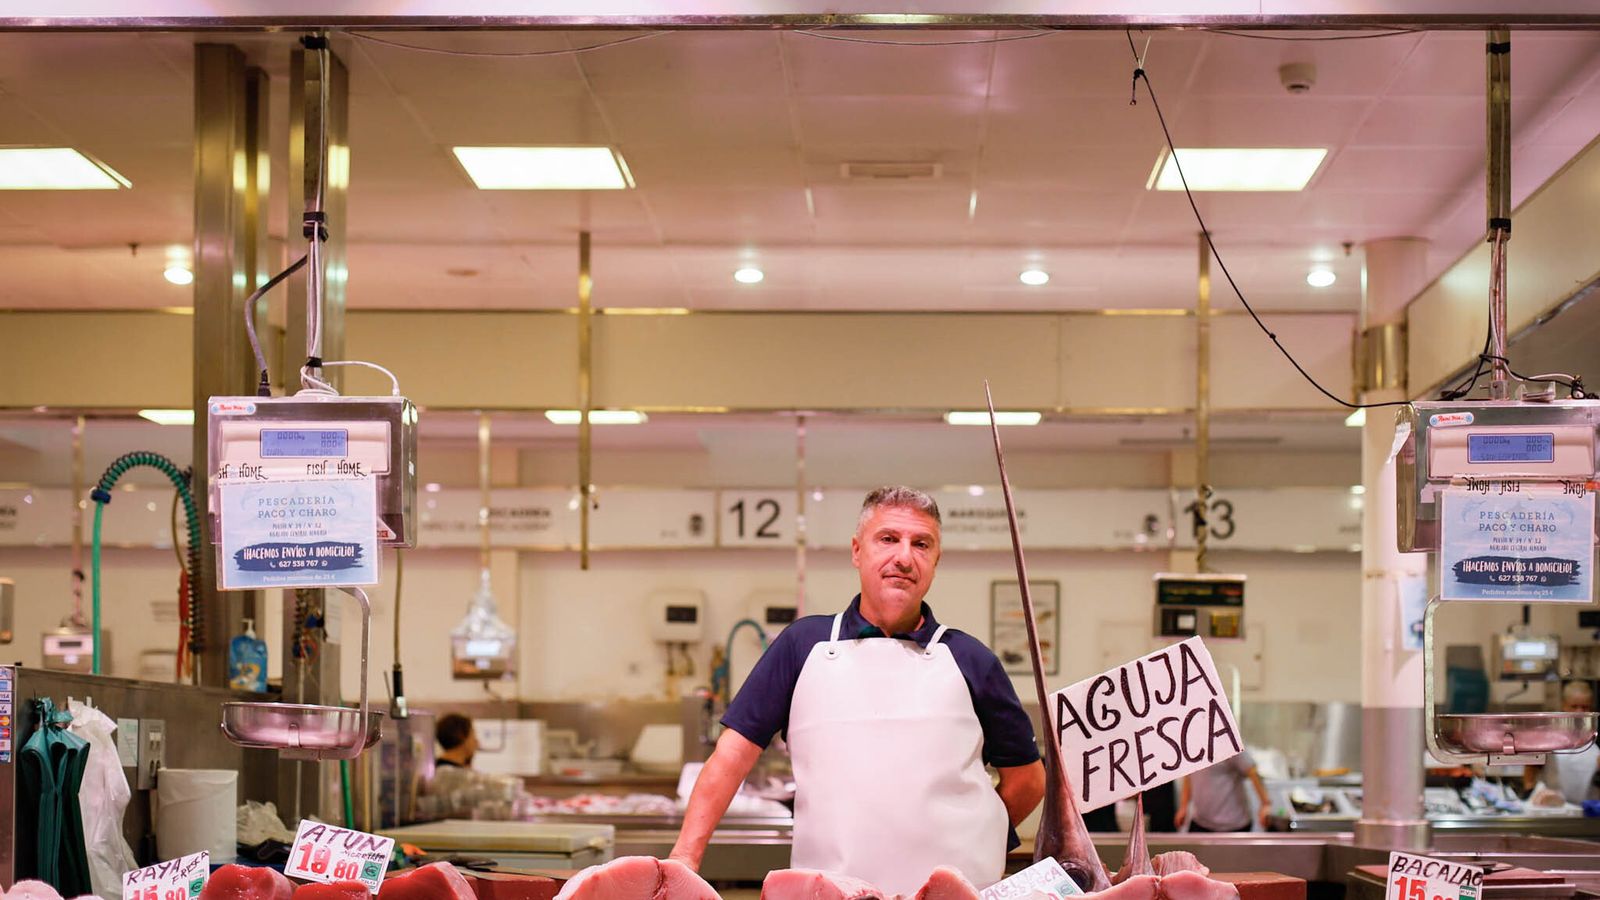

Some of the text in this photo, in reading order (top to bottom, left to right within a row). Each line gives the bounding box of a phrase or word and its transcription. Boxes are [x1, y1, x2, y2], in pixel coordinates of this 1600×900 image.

[218, 463, 268, 480] SH HOME
[307, 460, 367, 477] FISH HOME
[1462, 477, 1520, 495] FISH HOME
[258, 510, 286, 519] PACO
[299, 508, 337, 517] CHARO
[728, 499, 781, 538] 12
[1184, 500, 1235, 539] 13
[1479, 523, 1507, 532] PACO
[1519, 524, 1557, 532] CHARO
[308, 548, 314, 556] A
[279, 560, 291, 568] 627
[1528, 562, 1534, 571] A
[1057, 643, 1218, 747] AGUJA
[1082, 698, 1241, 802] FRESCA
[301, 825, 387, 852] ATUN
[127, 858, 182, 886] RAYA
[1391, 855, 1483, 887] BACALAO
[1394, 876, 1427, 900] 15
